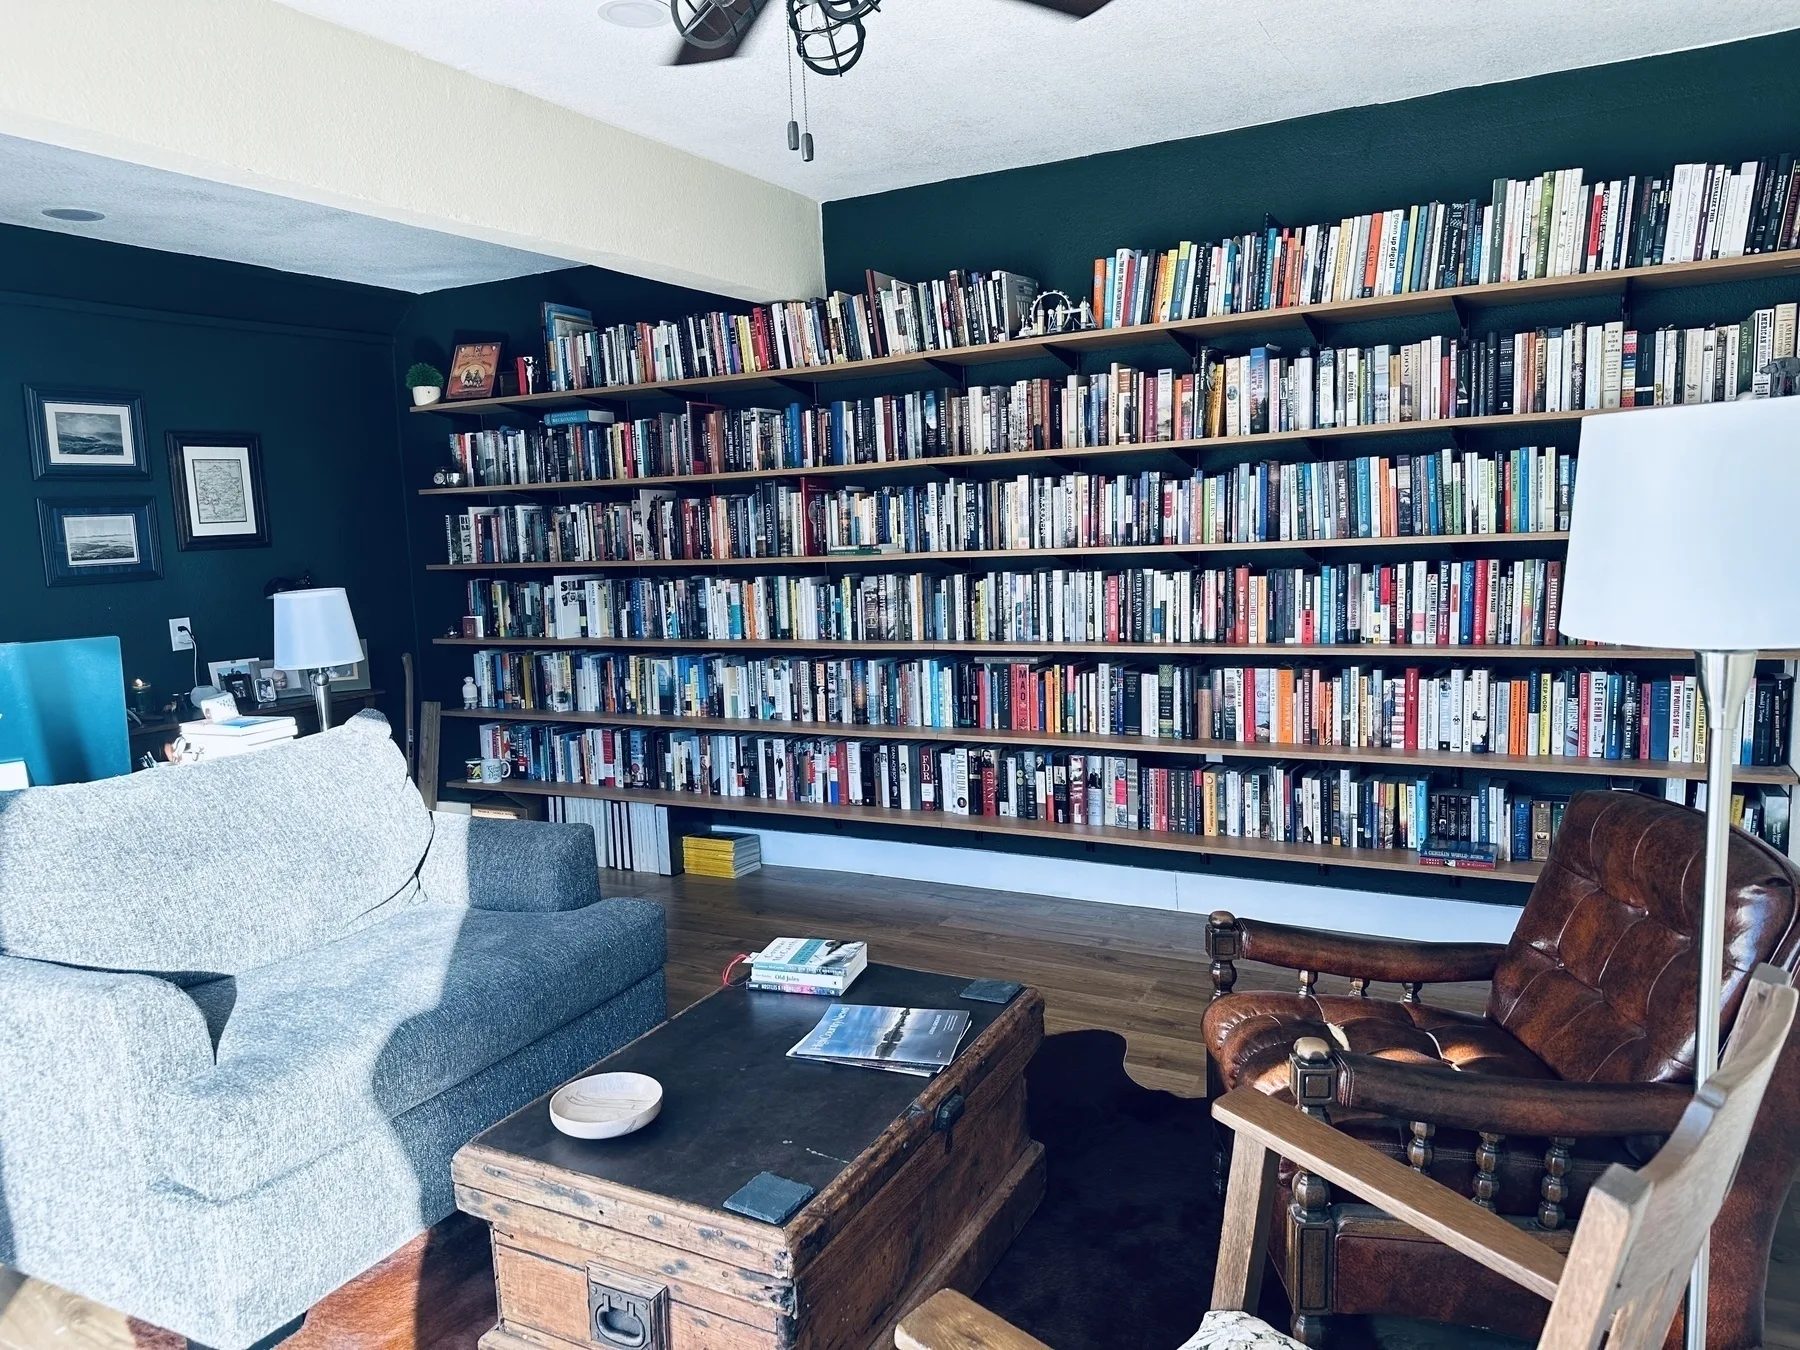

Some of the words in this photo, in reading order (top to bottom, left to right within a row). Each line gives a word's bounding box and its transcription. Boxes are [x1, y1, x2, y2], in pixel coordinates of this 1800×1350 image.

[1711, 177, 1720, 207] VISUALIZE
[1390, 236, 1397, 245] up
[1565, 221, 1573, 261] EXPLANATIONS
[1389, 247, 1397, 269] digital
[1595, 678, 1603, 695] LEFT
[1567, 697, 1578, 731] PARTISANS
[1594, 698, 1602, 722] BEHIND
[956, 754, 964, 791] CALHOUN
